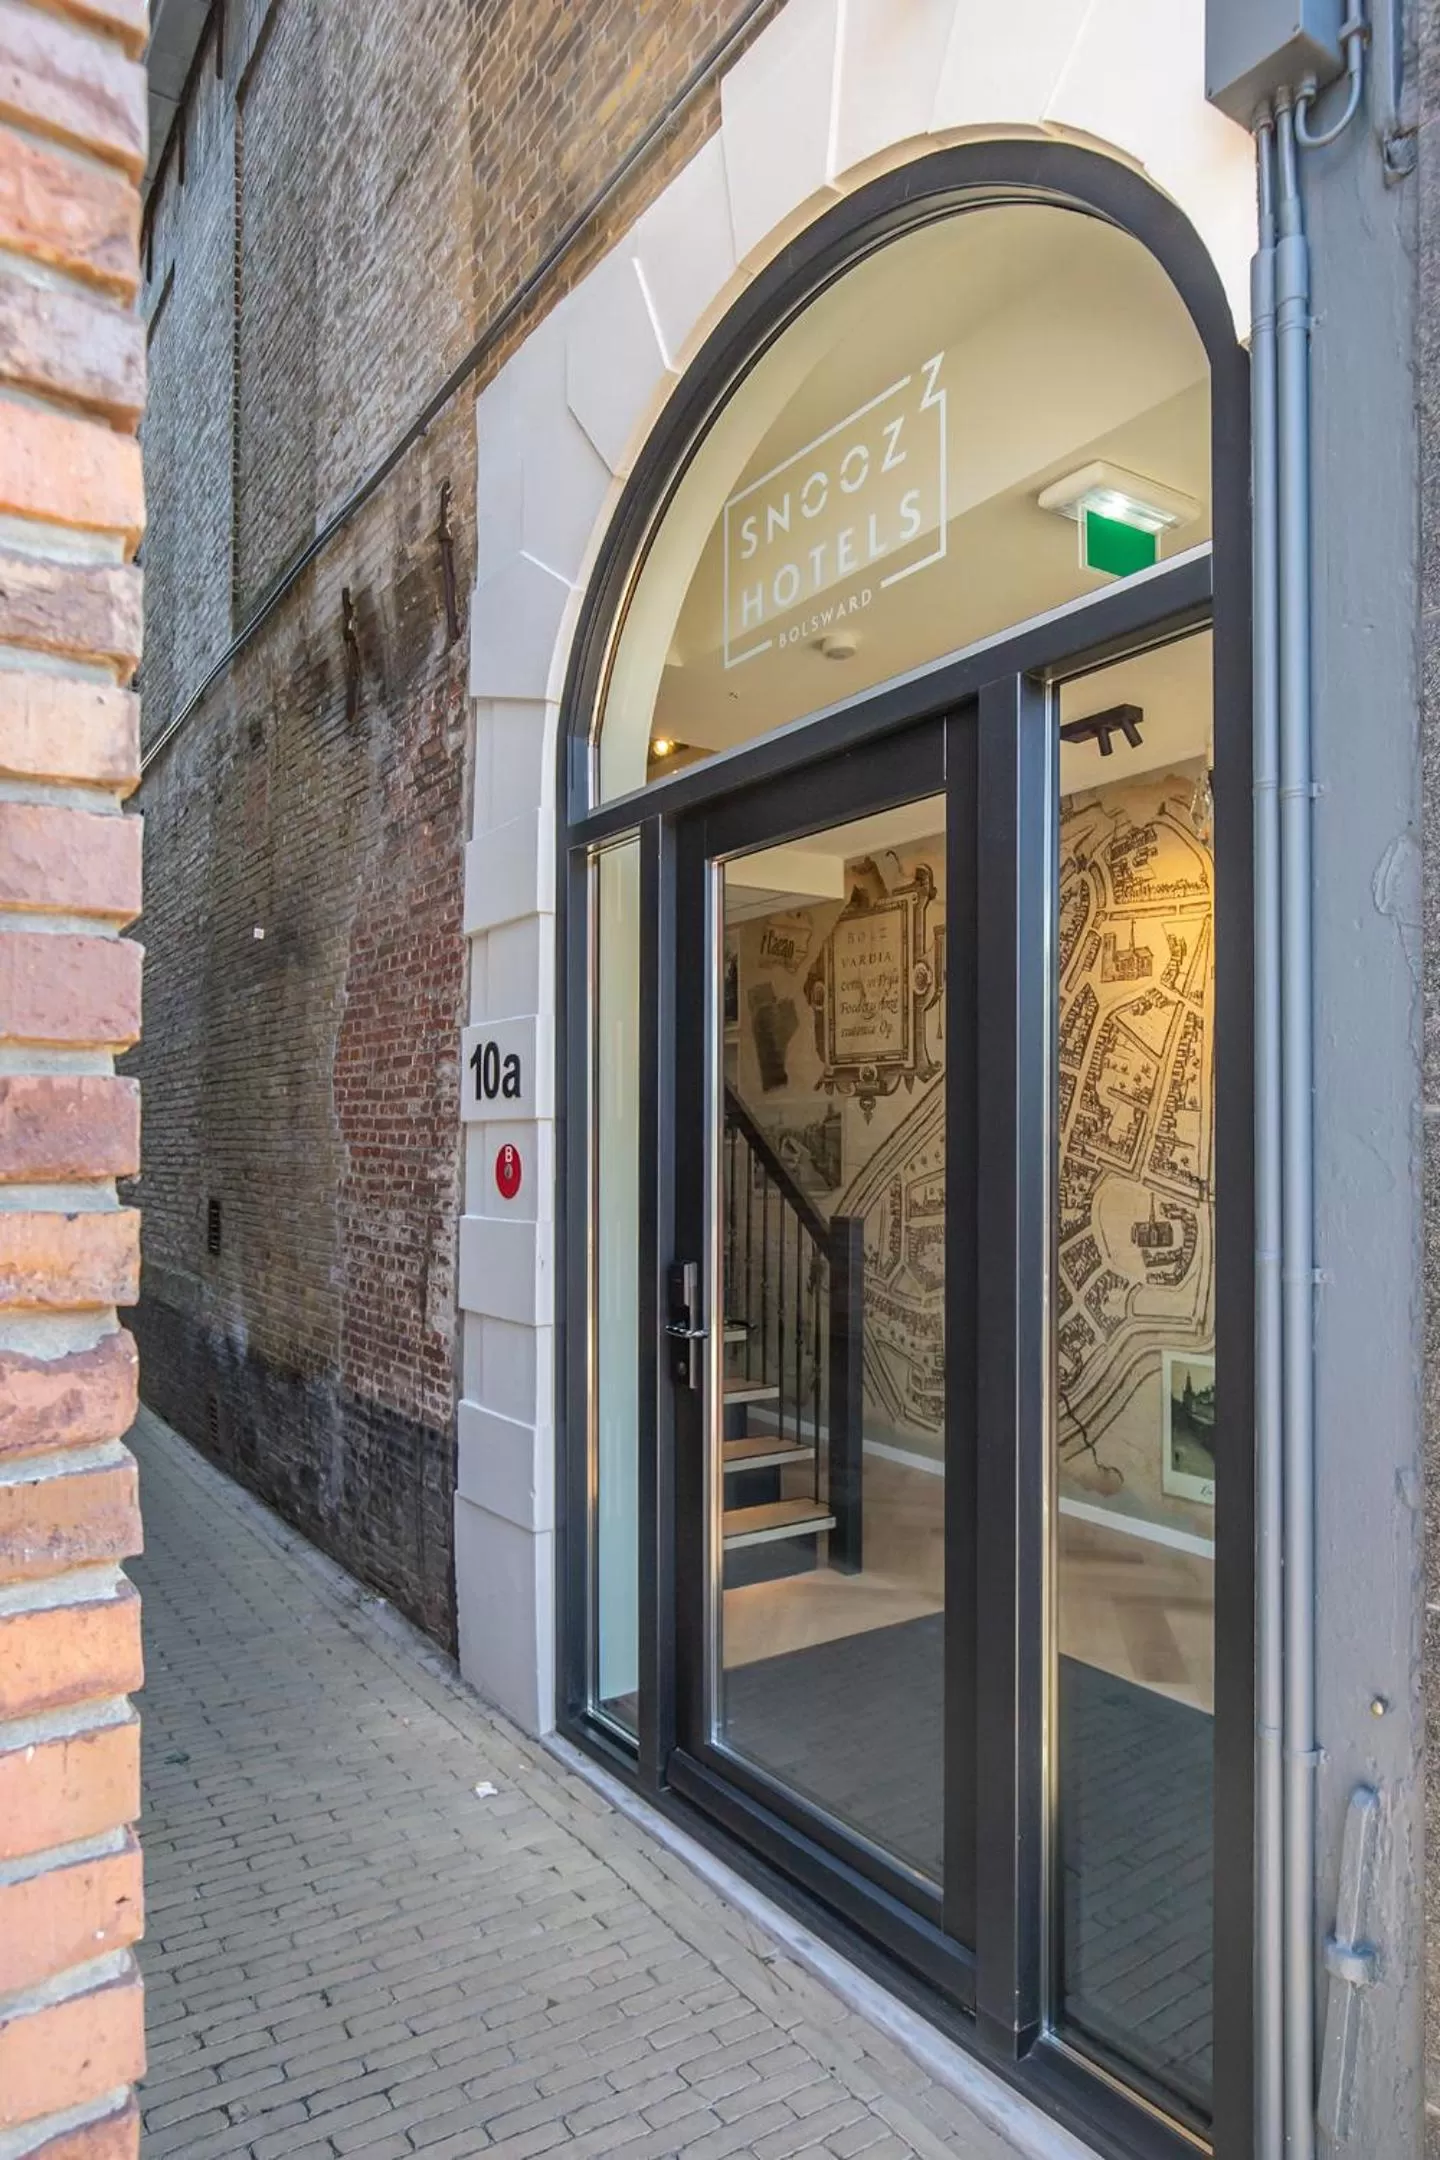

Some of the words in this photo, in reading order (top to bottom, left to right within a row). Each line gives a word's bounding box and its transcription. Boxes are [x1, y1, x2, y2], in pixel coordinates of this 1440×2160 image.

[742, 489, 921, 628] HOTELS
[779, 588, 872, 648] BOLSWARD
[470, 1041, 521, 1101] 10a
[504, 1145, 514, 1163] B
